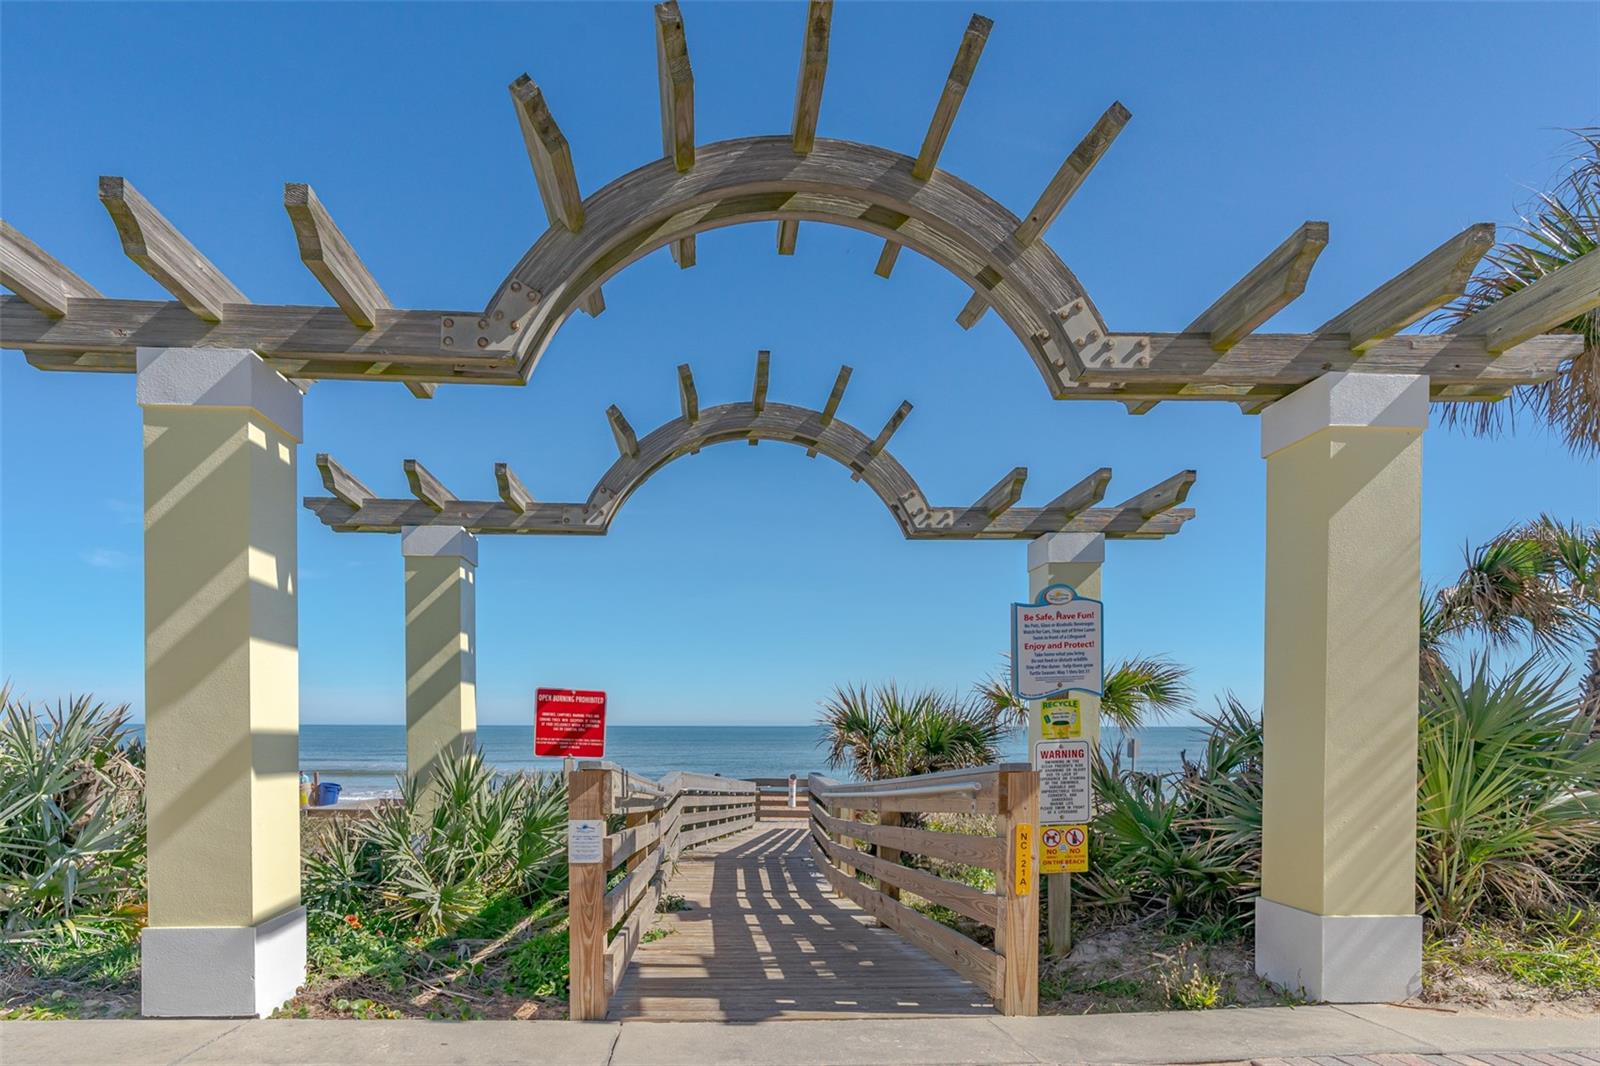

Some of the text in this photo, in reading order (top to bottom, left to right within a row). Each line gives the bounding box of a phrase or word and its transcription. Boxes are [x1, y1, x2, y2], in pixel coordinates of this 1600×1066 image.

[576, 696, 604, 704] PROHIBITED
[1043, 701, 1078, 709] RECYCLE
[1040, 749, 1084, 759] WARNING
